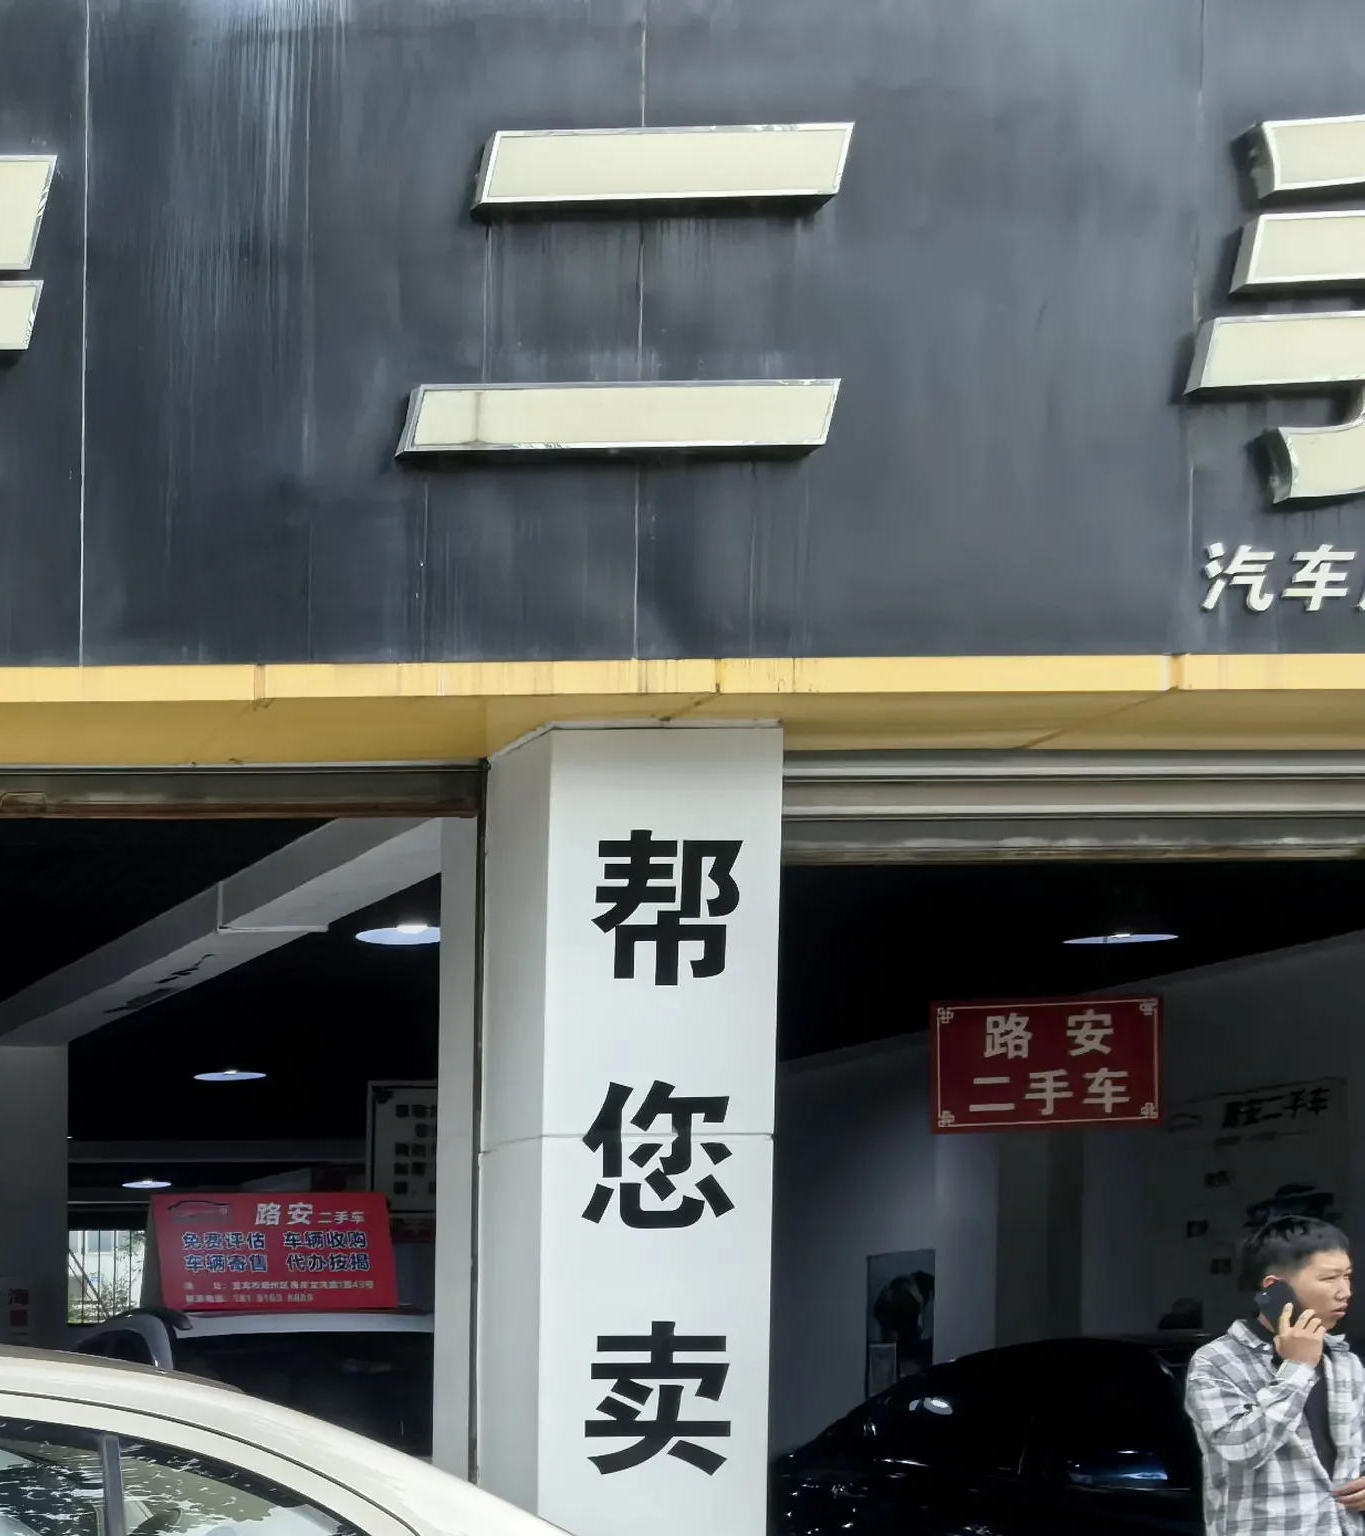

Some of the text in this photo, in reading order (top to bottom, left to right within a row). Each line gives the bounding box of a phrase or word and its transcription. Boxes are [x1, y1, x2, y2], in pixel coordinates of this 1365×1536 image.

[1201, 541, 1365, 613] 汽车
[983, 1009, 1114, 1060] 路安
[969, 1067, 1131, 1116] 二手车
[181, 1230, 367, 1251] 免费评估 车辆收购
[184, 1253, 370, 1273] 车辆寄售 代办按揭
